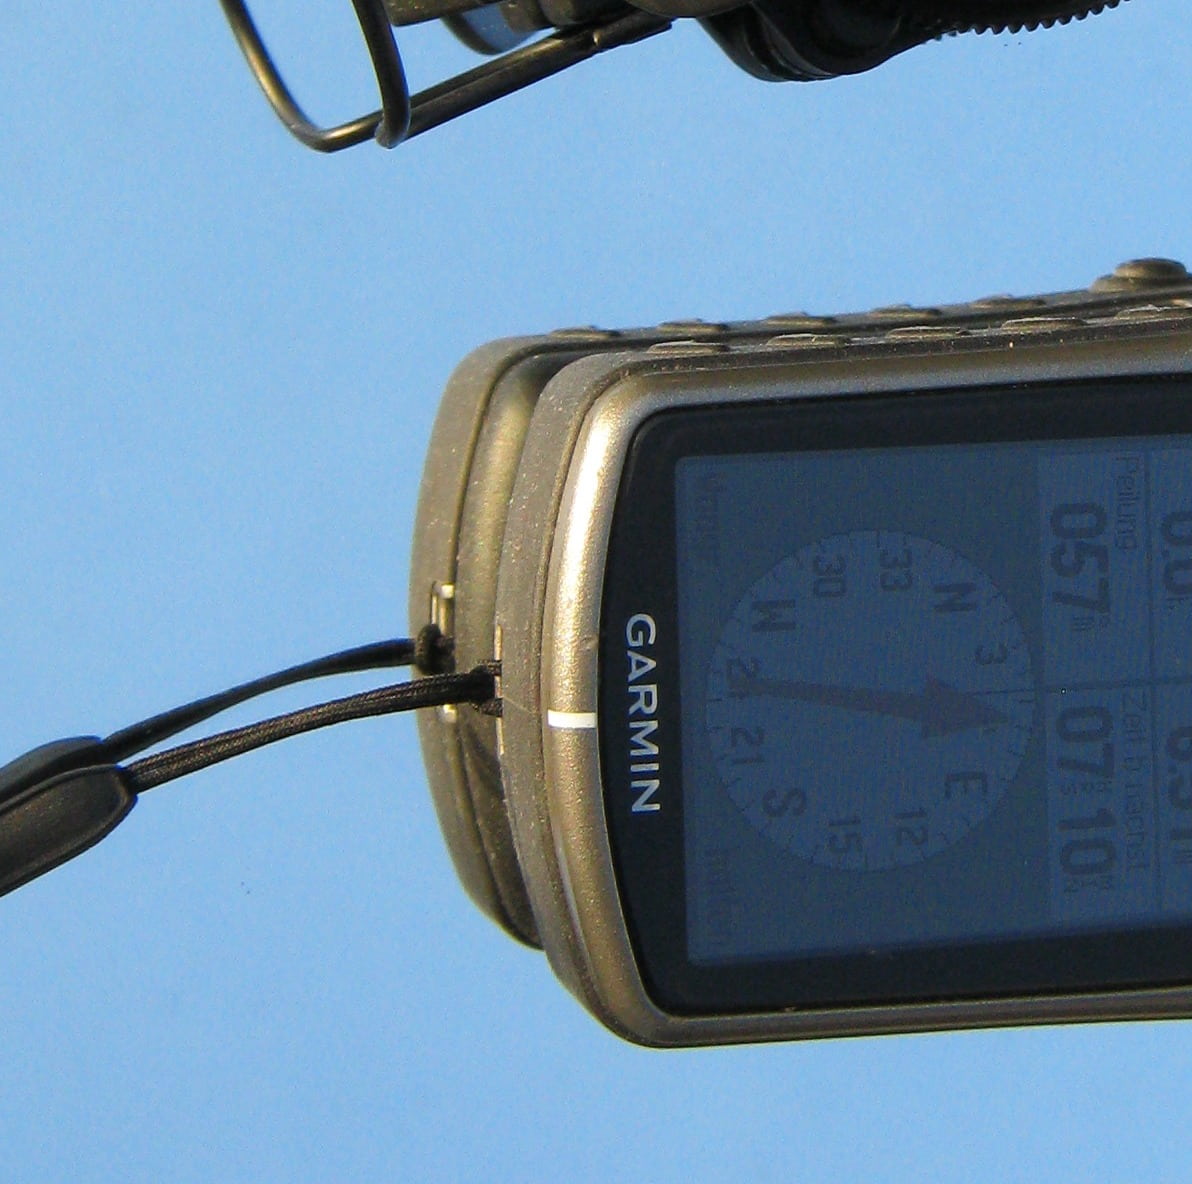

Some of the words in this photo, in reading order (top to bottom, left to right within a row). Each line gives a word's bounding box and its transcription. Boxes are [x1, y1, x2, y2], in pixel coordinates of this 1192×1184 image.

[1115, 455, 1141, 550] Peilung
[812, 554, 847, 598] 30
[879, 548, 912, 592] 33
[1050, 502, 1111, 613] 057
[751, 598, 797, 633] W
[933, 582, 978, 614] N
[975, 643, 1008, 666] 3
[625, 612, 662, 813] GARMIN
[731, 726, 766, 765] 21
[1055, 705, 1115, 779] 07
[761, 788, 808, 818] S
[944, 771, 989, 800] E
[828, 816, 863, 854] 15
[894, 806, 929, 847] 12
[1058, 807, 1117, 876] 10
